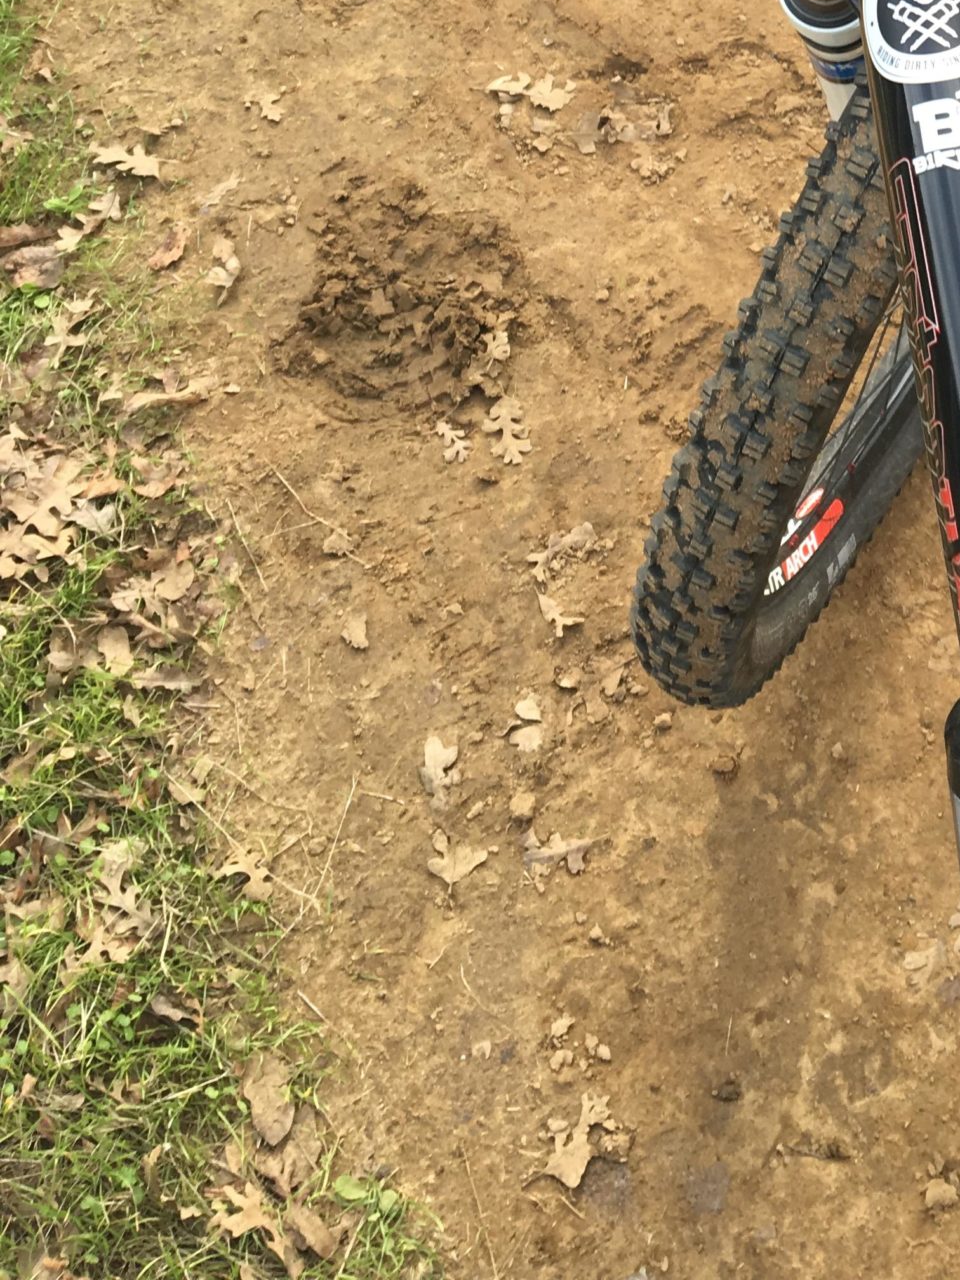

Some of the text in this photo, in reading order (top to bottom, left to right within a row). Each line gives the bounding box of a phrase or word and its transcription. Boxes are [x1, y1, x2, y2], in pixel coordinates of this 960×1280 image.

[877, 45, 901, 69] RIDING
[904, 58, 936, 71] DIRTY
[785, 529, 819, 582] ARCH
